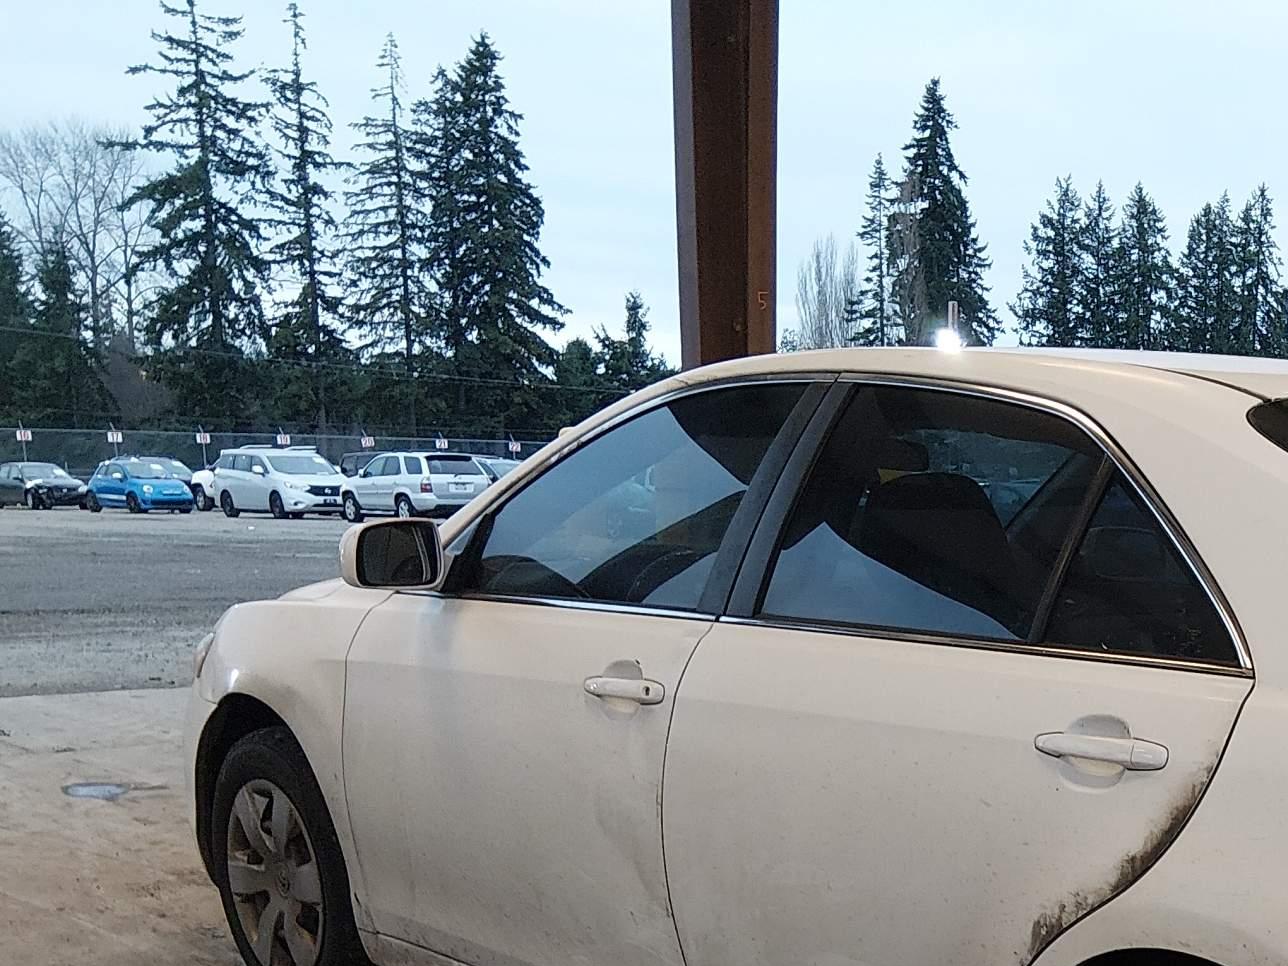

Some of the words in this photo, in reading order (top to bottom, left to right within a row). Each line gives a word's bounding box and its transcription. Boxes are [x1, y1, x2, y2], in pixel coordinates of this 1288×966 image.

[758, 291, 768, 310] 5
[112, 432, 120, 442] 17
[438, 439, 447, 449] 21
